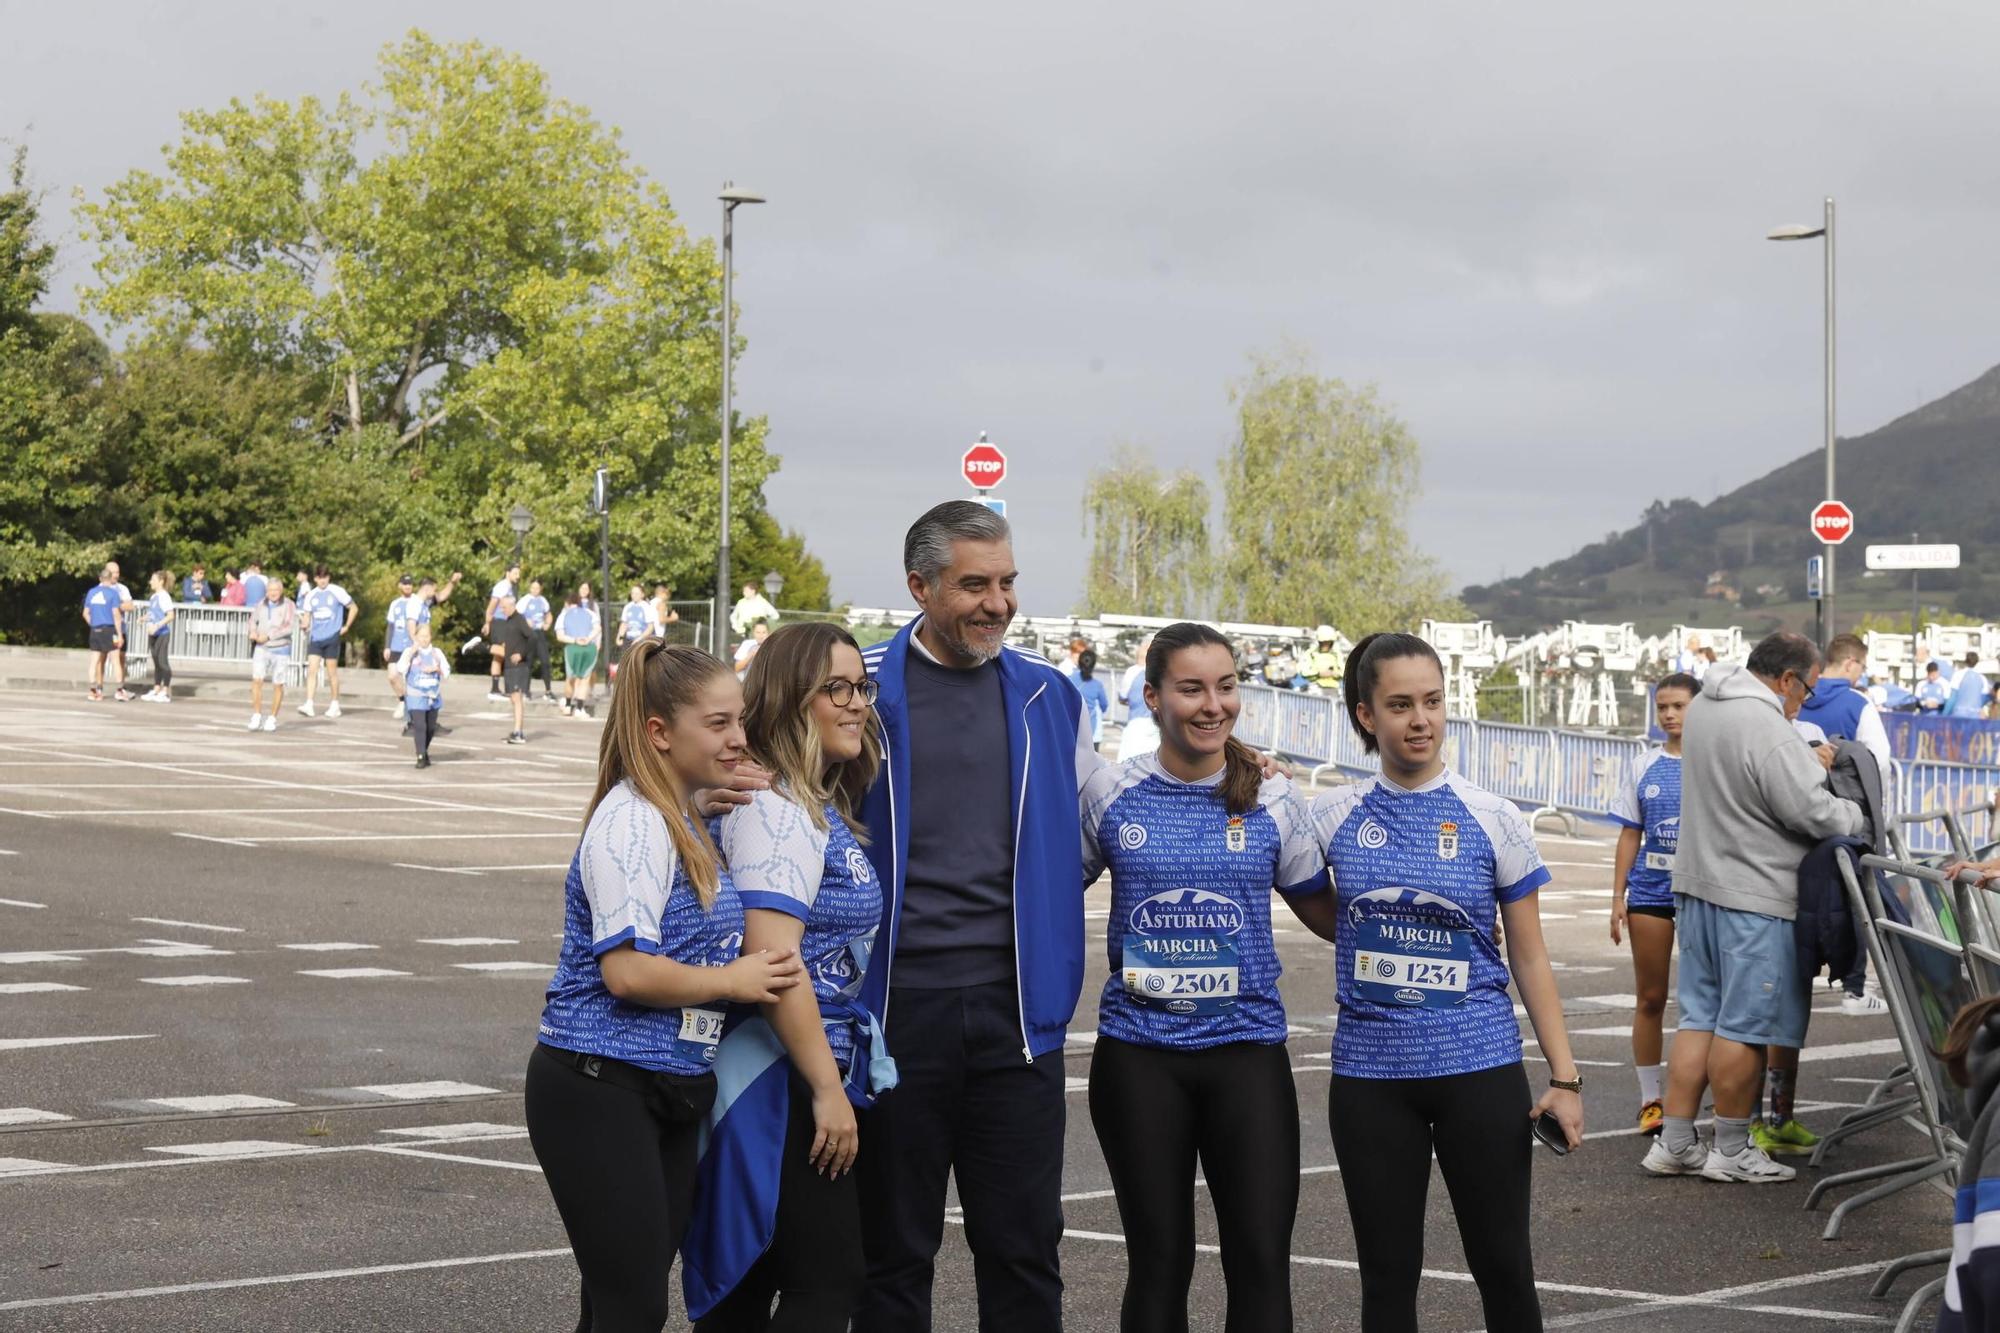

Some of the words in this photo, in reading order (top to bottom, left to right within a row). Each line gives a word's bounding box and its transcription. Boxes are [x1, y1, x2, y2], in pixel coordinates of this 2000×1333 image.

[967, 461, 1001, 472] STOP
[1816, 517, 1848, 528] STOP
[1898, 552, 1952, 561] SALIDA
[1138, 908, 1239, 929] ASTURIANA
[1379, 925, 1452, 944] MARCHA
[1144, 939, 1217, 952] MARCHA
[1406, 963, 1456, 986] 1234
[1171, 973, 1229, 993] 2304
